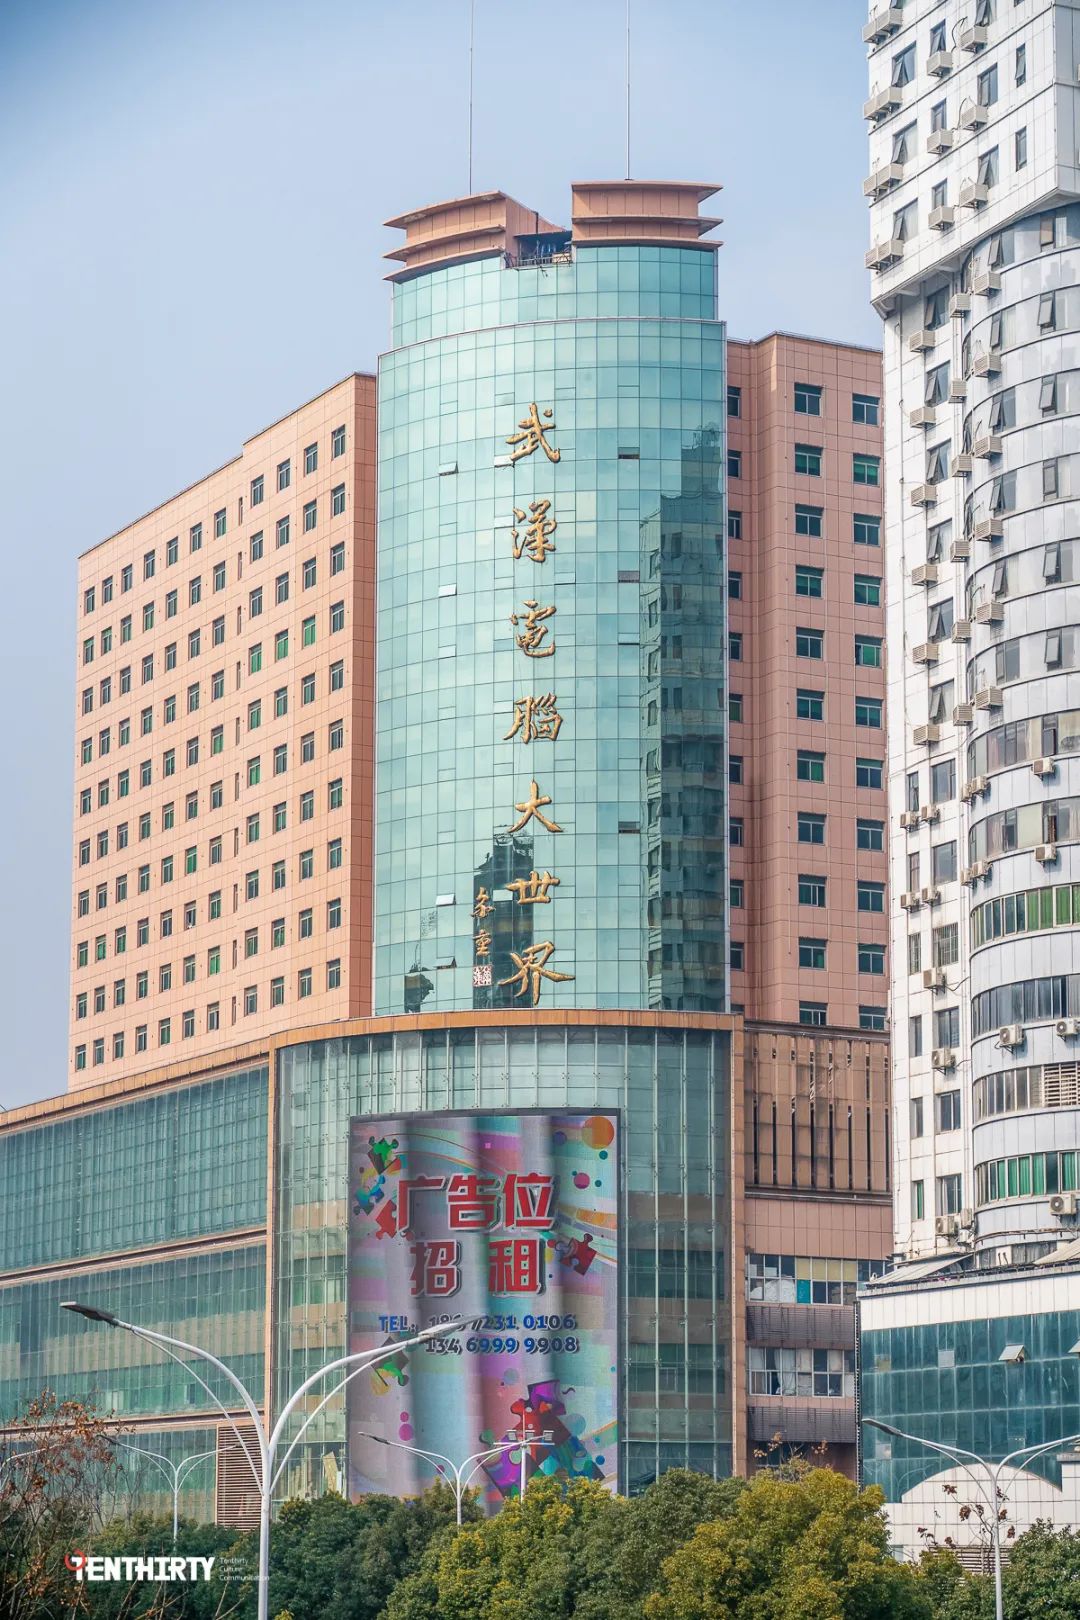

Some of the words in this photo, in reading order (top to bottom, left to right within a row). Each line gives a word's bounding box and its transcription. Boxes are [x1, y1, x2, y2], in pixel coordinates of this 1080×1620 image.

[397, 1173, 556, 1231] 广告位
[523, 1314, 577, 1331] 0106
[425, 1338, 461, 1354] 134
[466, 1337, 518, 1354] 6999
[524, 1337, 579, 1354] 9908
